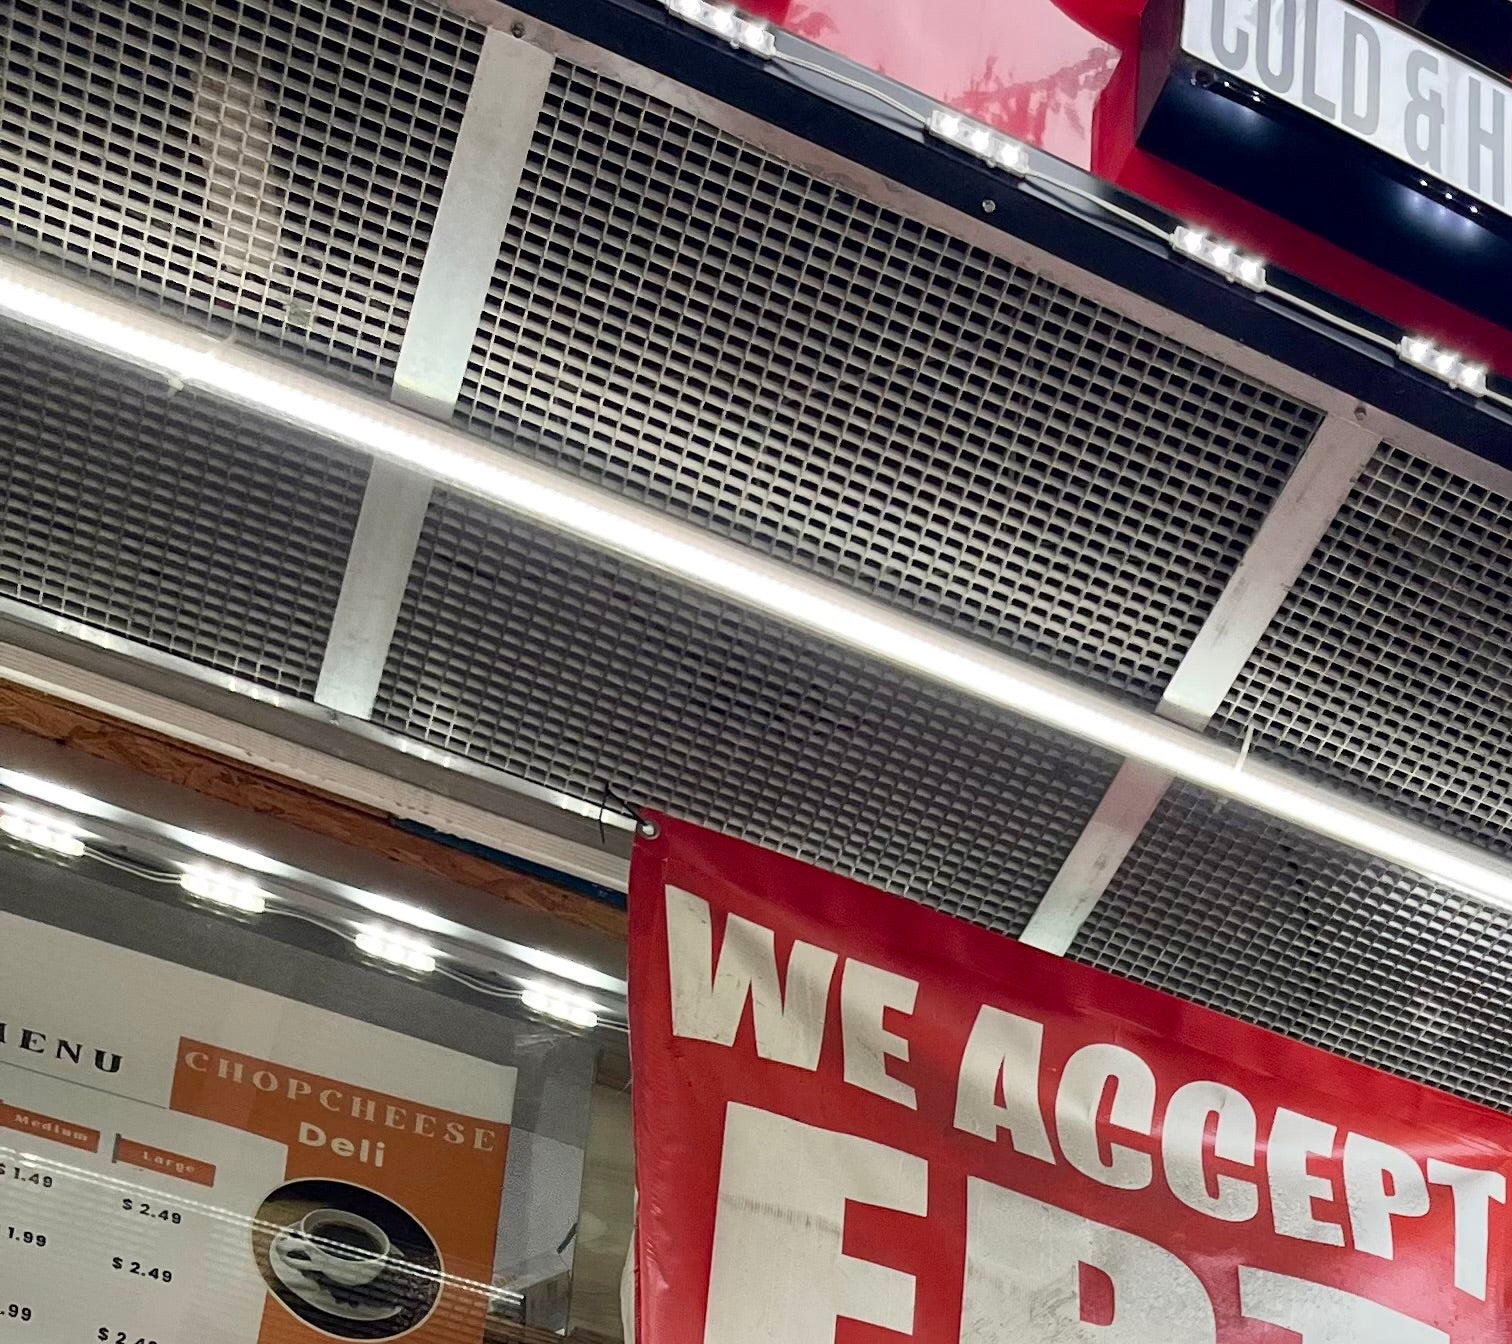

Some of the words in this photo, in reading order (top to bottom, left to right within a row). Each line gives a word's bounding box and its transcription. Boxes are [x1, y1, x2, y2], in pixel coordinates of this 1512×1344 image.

[1403, 48, 1446, 174] &
[0, 1022, 123, 1074] ENU
[184, 1050, 498, 1153] CHOPCHEESE
[664, 884, 920, 1110] WE
[952, 1004, 1507, 1301] ACCEPT
[15, 1113, 88, 1143] Medium
[143, 1150, 195, 1174] Large
[297, 1121, 386, 1169] Deli
[14, 1166, 53, 1189] 1.49
[8, 1226, 47, 1247] 1.99
[139, 1203, 182, 1225] 2.49
[130, 1262, 172, 1283] 2.49
